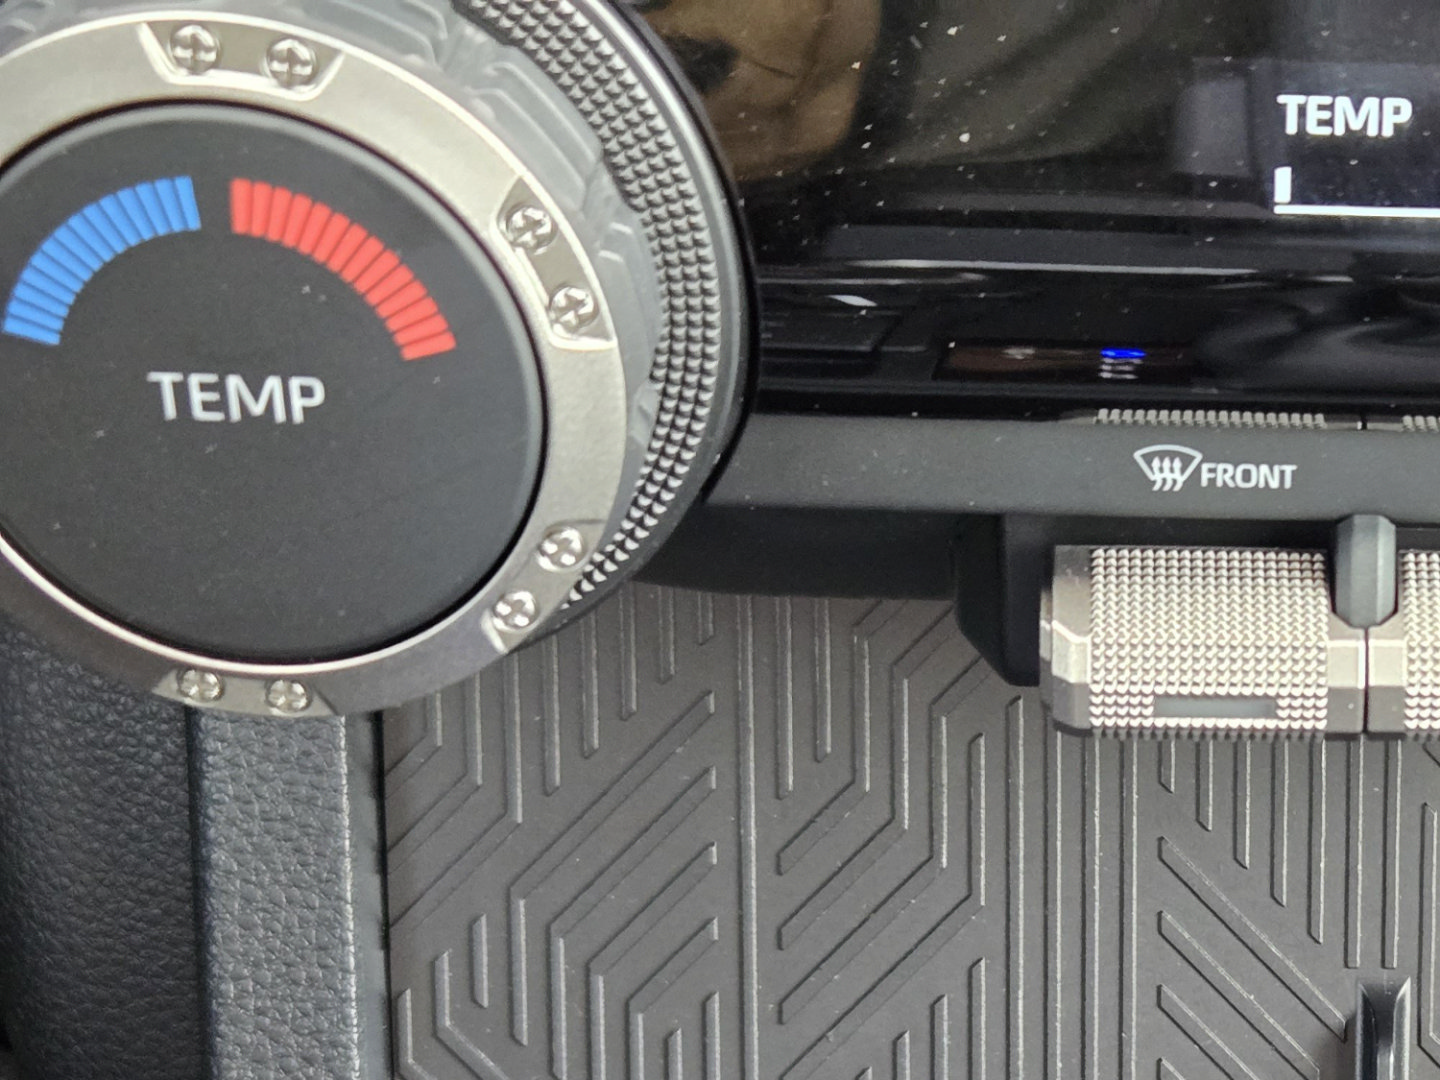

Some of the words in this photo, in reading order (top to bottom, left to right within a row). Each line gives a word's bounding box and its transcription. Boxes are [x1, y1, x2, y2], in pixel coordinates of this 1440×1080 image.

[1277, 94, 1413, 139] TEMP
[146, 371, 327, 426] TEMP
[1200, 462, 1298, 491] FRONT
